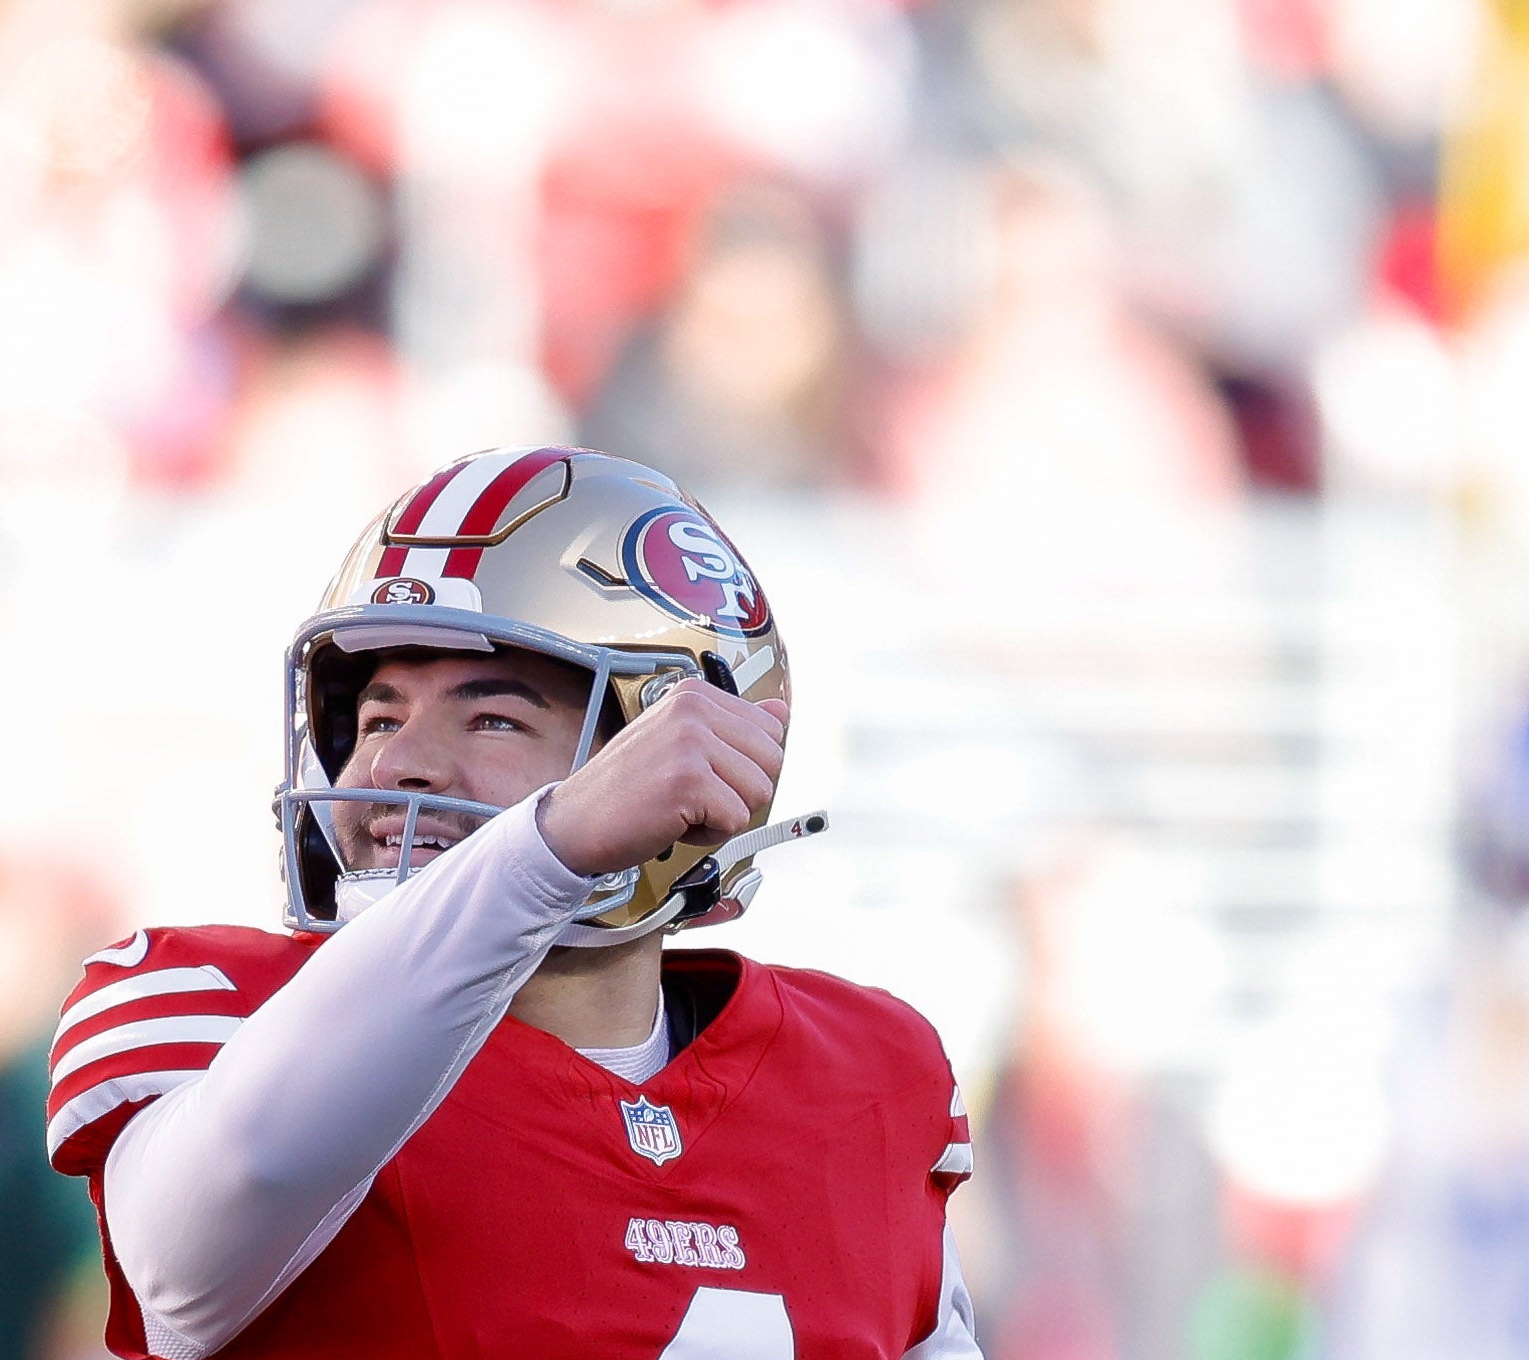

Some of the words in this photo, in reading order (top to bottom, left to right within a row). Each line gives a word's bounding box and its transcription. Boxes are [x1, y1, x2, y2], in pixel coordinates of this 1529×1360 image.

[668, 520, 758, 619] SF
[790, 820, 803, 837] 4
[637, 1124, 673, 1150] NFL
[625, 1218, 746, 1270] 49ERS
